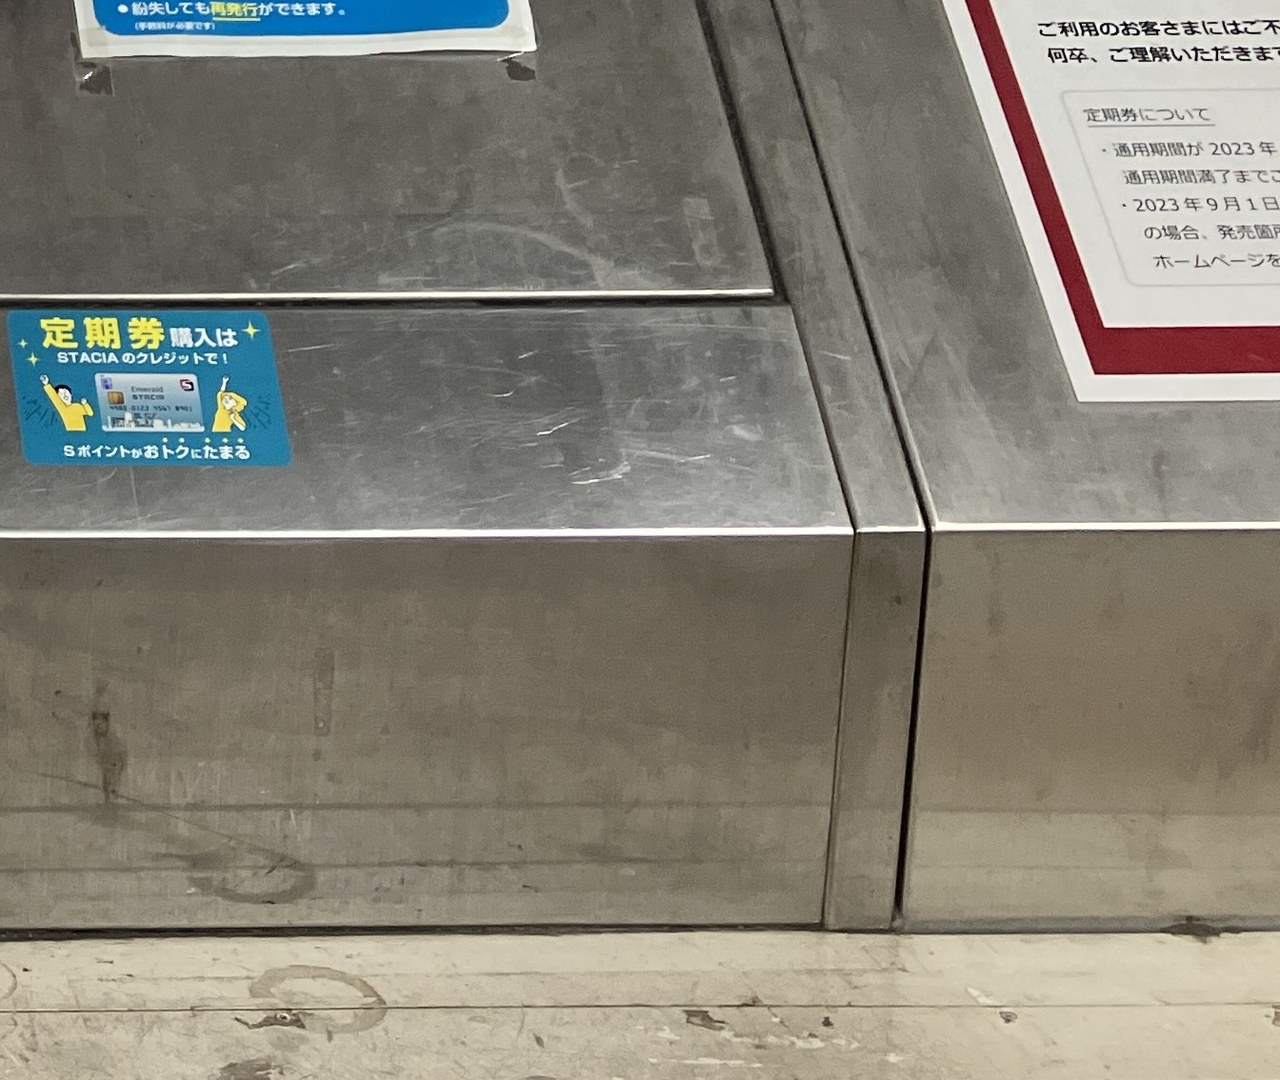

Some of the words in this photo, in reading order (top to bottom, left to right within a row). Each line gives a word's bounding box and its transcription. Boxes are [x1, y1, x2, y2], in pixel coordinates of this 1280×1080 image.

[1083, 107, 1211, 123] 定期券について
